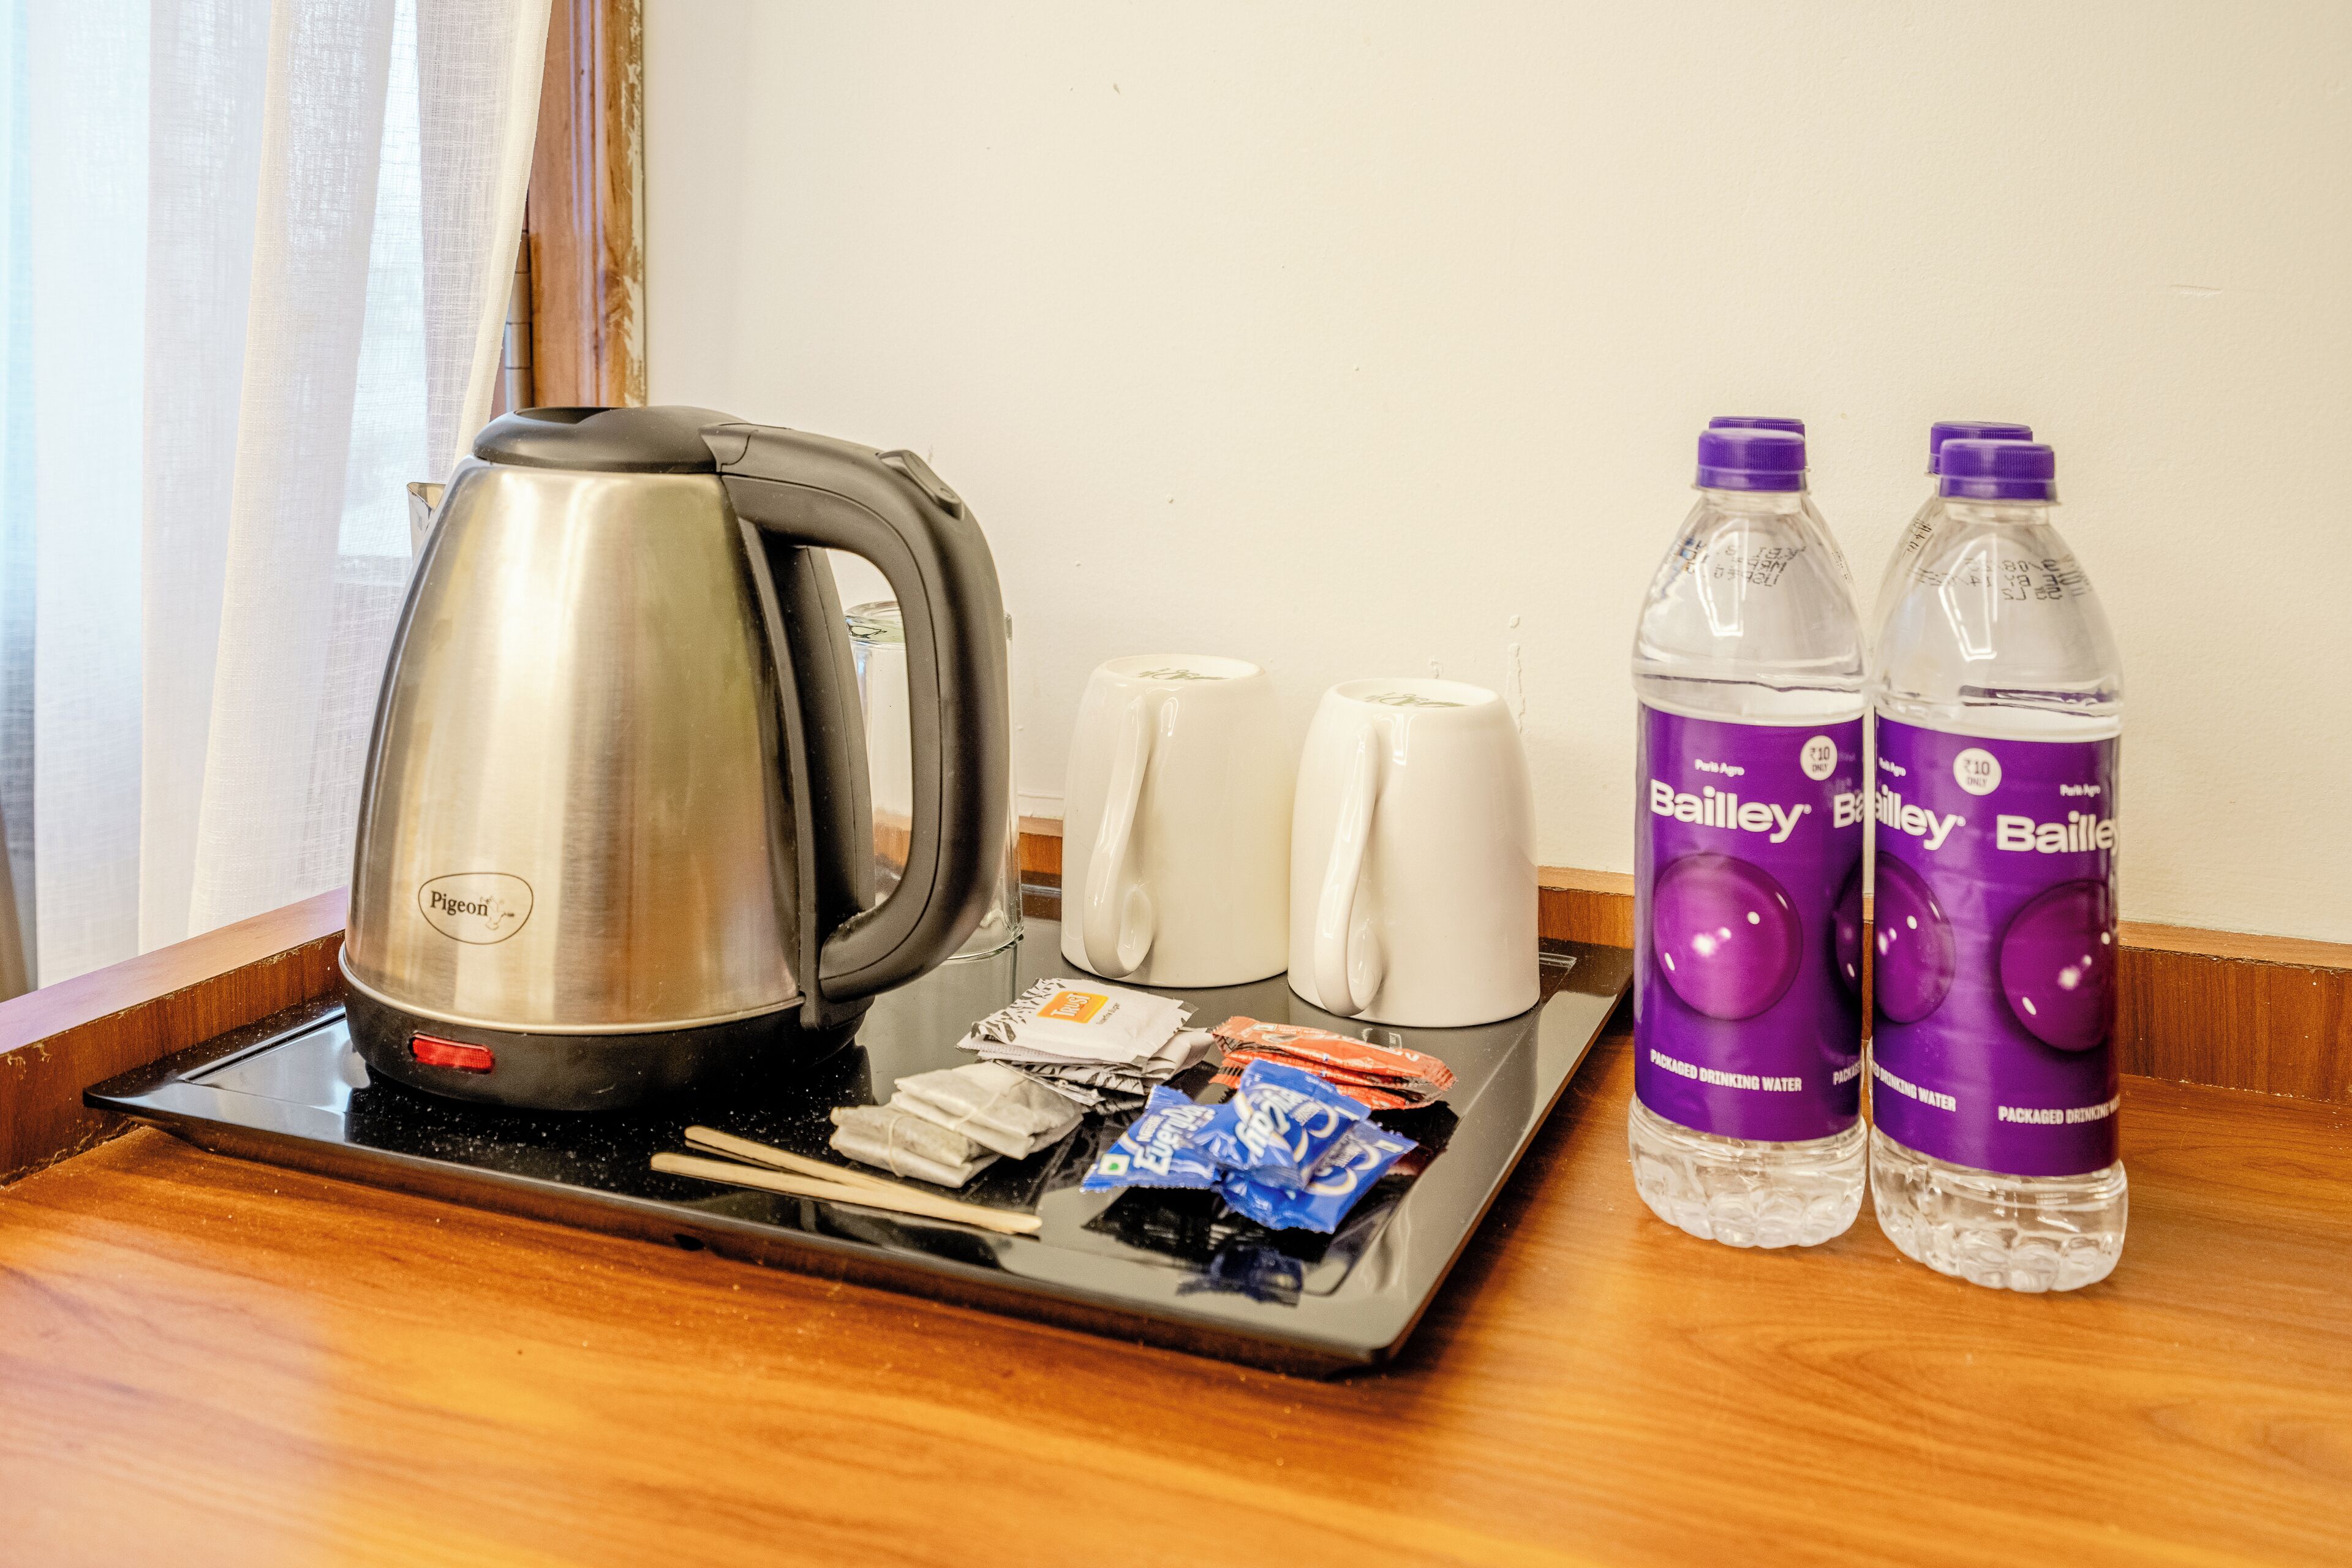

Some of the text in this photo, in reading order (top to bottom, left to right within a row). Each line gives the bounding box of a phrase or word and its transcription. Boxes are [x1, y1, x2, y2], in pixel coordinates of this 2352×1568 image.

[1650, 778, 1806, 844] Bailley
[1875, 784, 1959, 851] ailley
[429, 890, 488, 916] Pigeon
[1650, 1048, 1802, 1092] PACKAGED DRINKING WATER
[1880, 1066, 1917, 1099] DRINKING
[1918, 1087, 1956, 1112] WATER
[1998, 1106, 2064, 1125] PACKAGED
[2065, 1102, 2109, 1125] DRINKING
